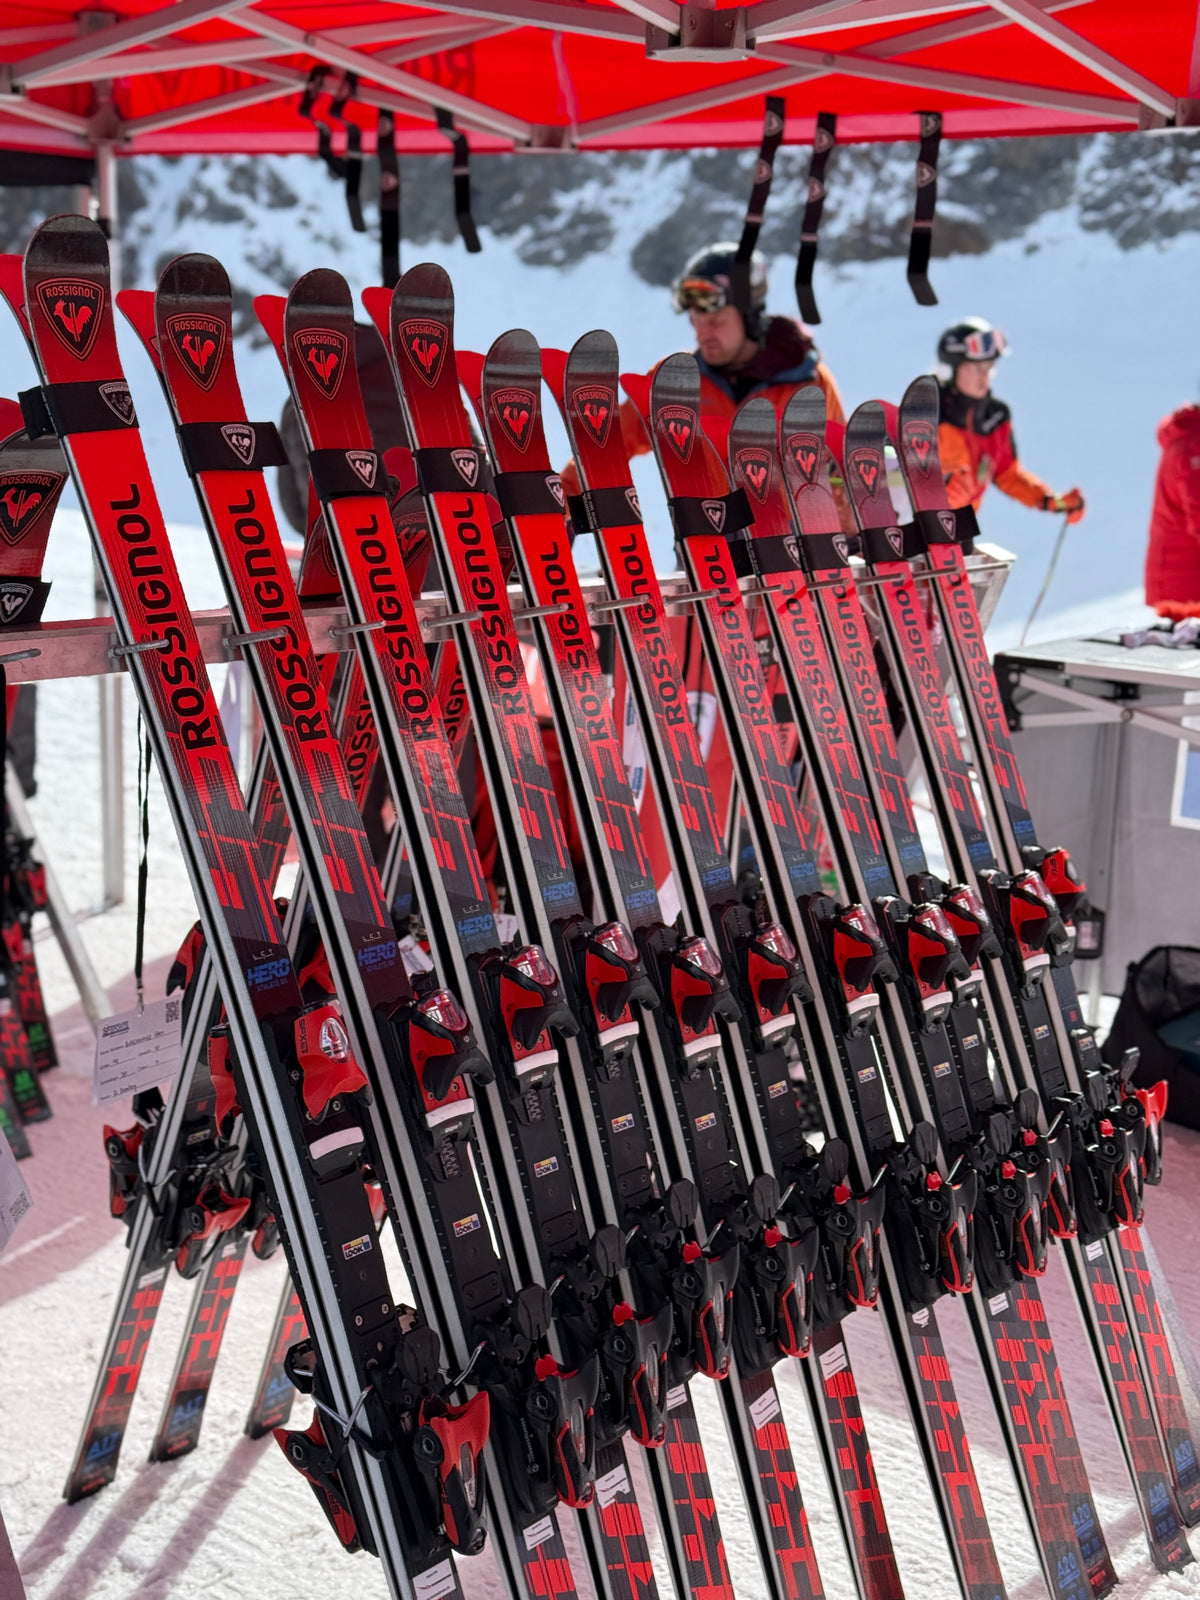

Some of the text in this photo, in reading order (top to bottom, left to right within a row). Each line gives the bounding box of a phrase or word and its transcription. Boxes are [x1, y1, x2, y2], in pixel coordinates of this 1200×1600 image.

[46, 285, 95, 300] ROSSIGNOL
[174, 320, 218, 334] ROSSIGNOL
[405, 325, 442, 339] ROSSIGNOL
[300, 335, 342, 349] ROSSIGNOL
[0, 474, 52, 487] ROSSIGNOL
[110, 483, 219, 751] ROSSIGNOL
[228, 490, 328, 743] ROSSIGNOL
[453, 497, 528, 717] ROSSIGNOL
[355, 514, 437, 743] ROSSIGNOL
[620, 533, 685, 727] ROSSIGNOL
[540, 542, 610, 742] ROSSIGNOL
[782, 579, 844, 745] ROSSIGNOL
[543, 881, 576, 902] HERO
[458, 914, 494, 936] HERO
[358, 941, 397, 966] HERO
[248, 958, 291, 985] HERO
[536, 1164, 552, 1176] LOOK
[456, 1223, 473, 1235] LOOK
[345, 1245, 364, 1258] LOOK
